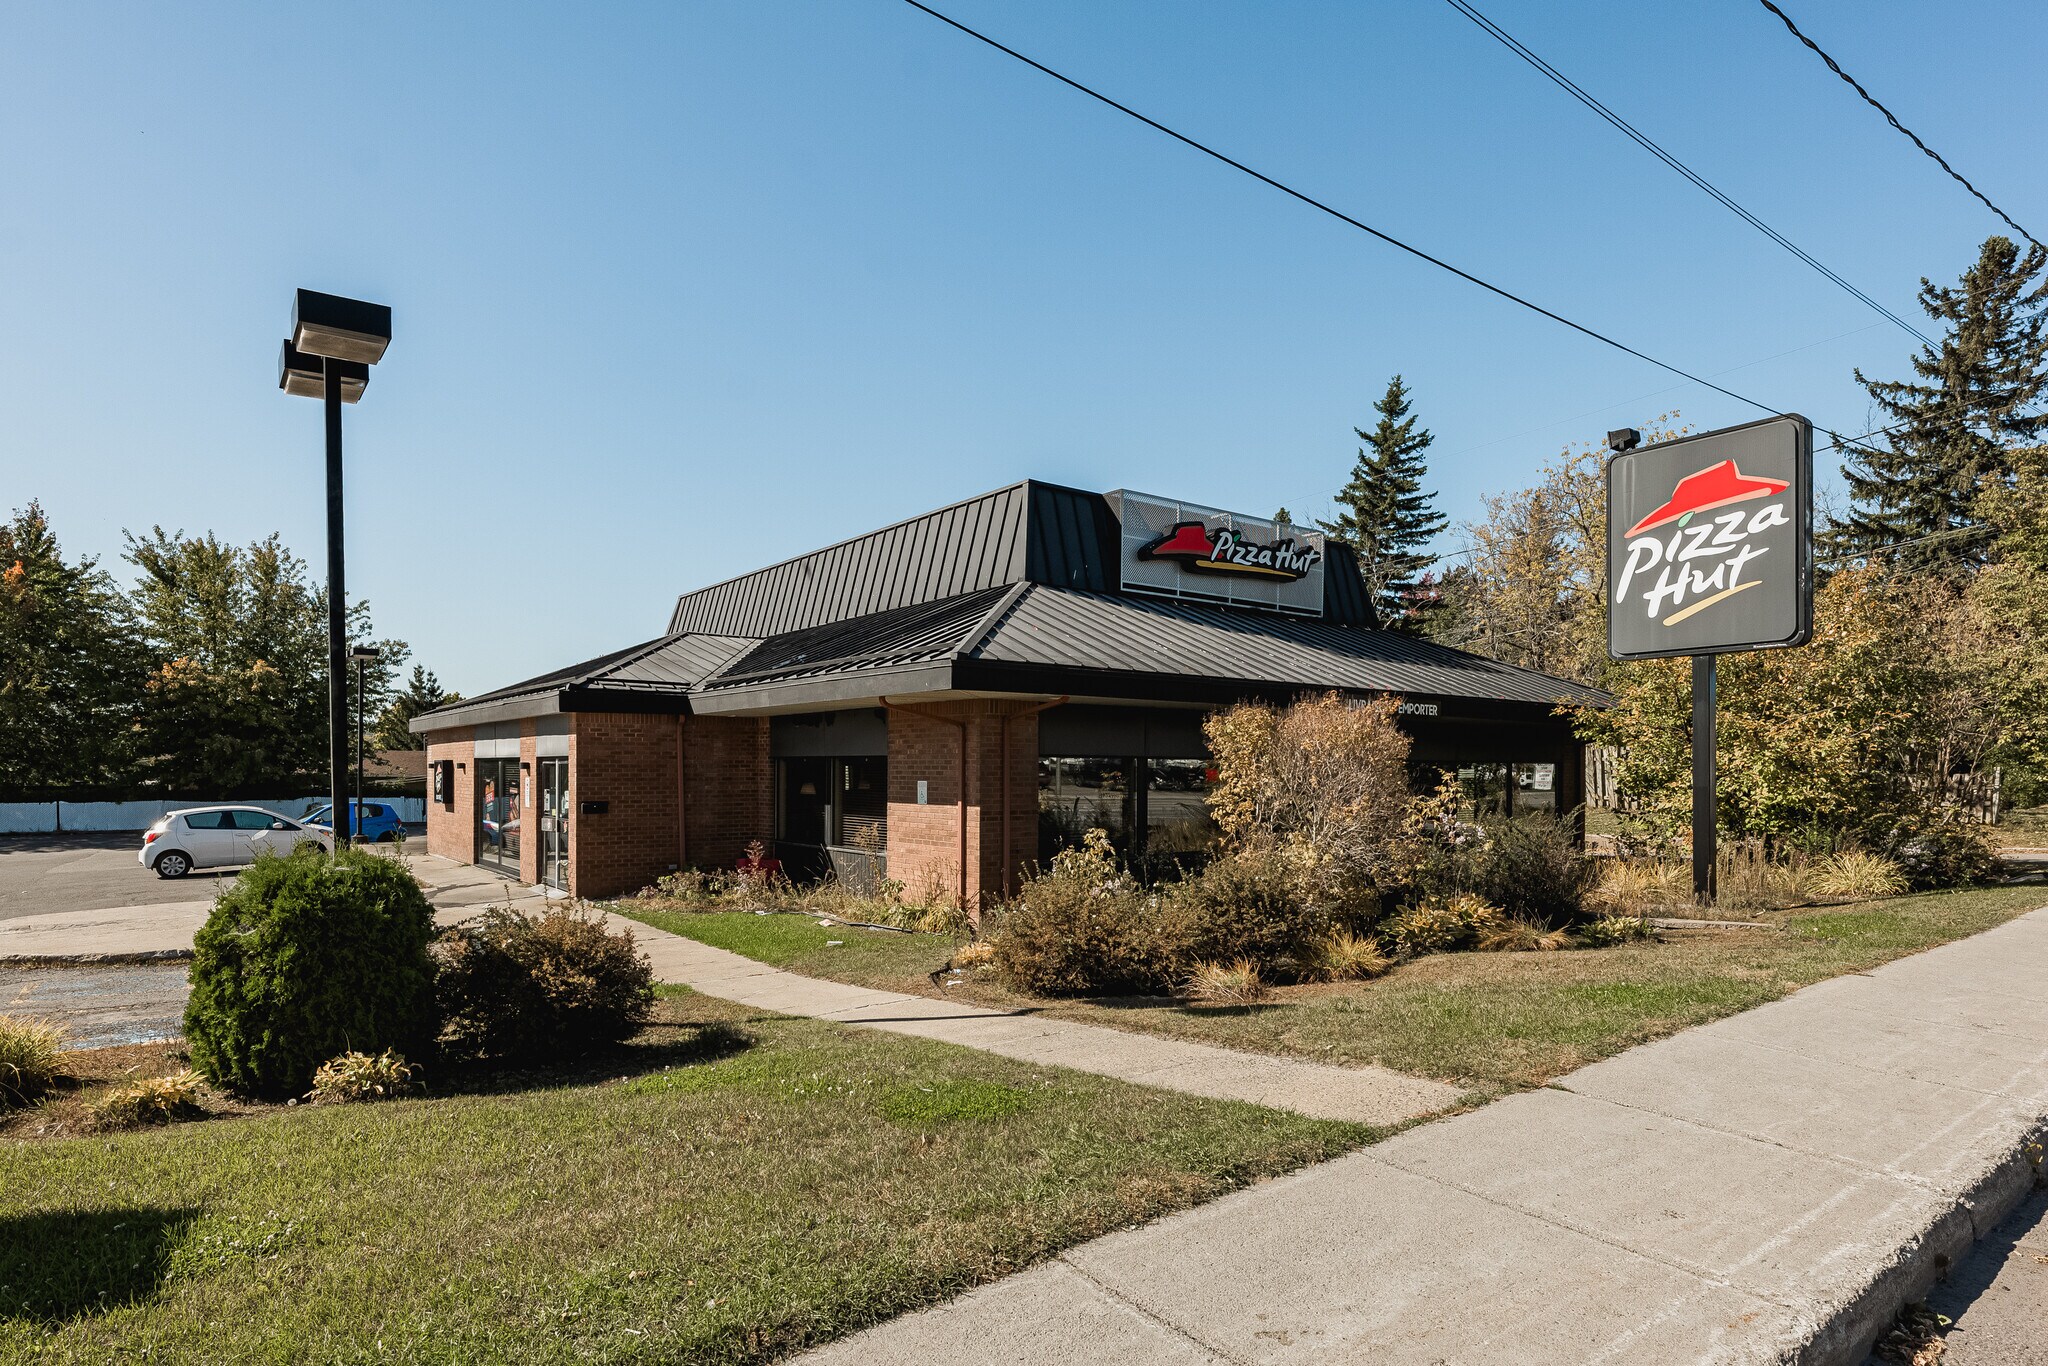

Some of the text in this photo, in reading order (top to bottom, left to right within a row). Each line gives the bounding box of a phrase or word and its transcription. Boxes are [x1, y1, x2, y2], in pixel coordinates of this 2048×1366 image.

[1210, 531, 1320, 572] Pizza Hut
[1616, 503, 1790, 604] Pizza
[1643, 544, 1770, 619] Hut
[1398, 703, 1438, 716] EMPORTER
